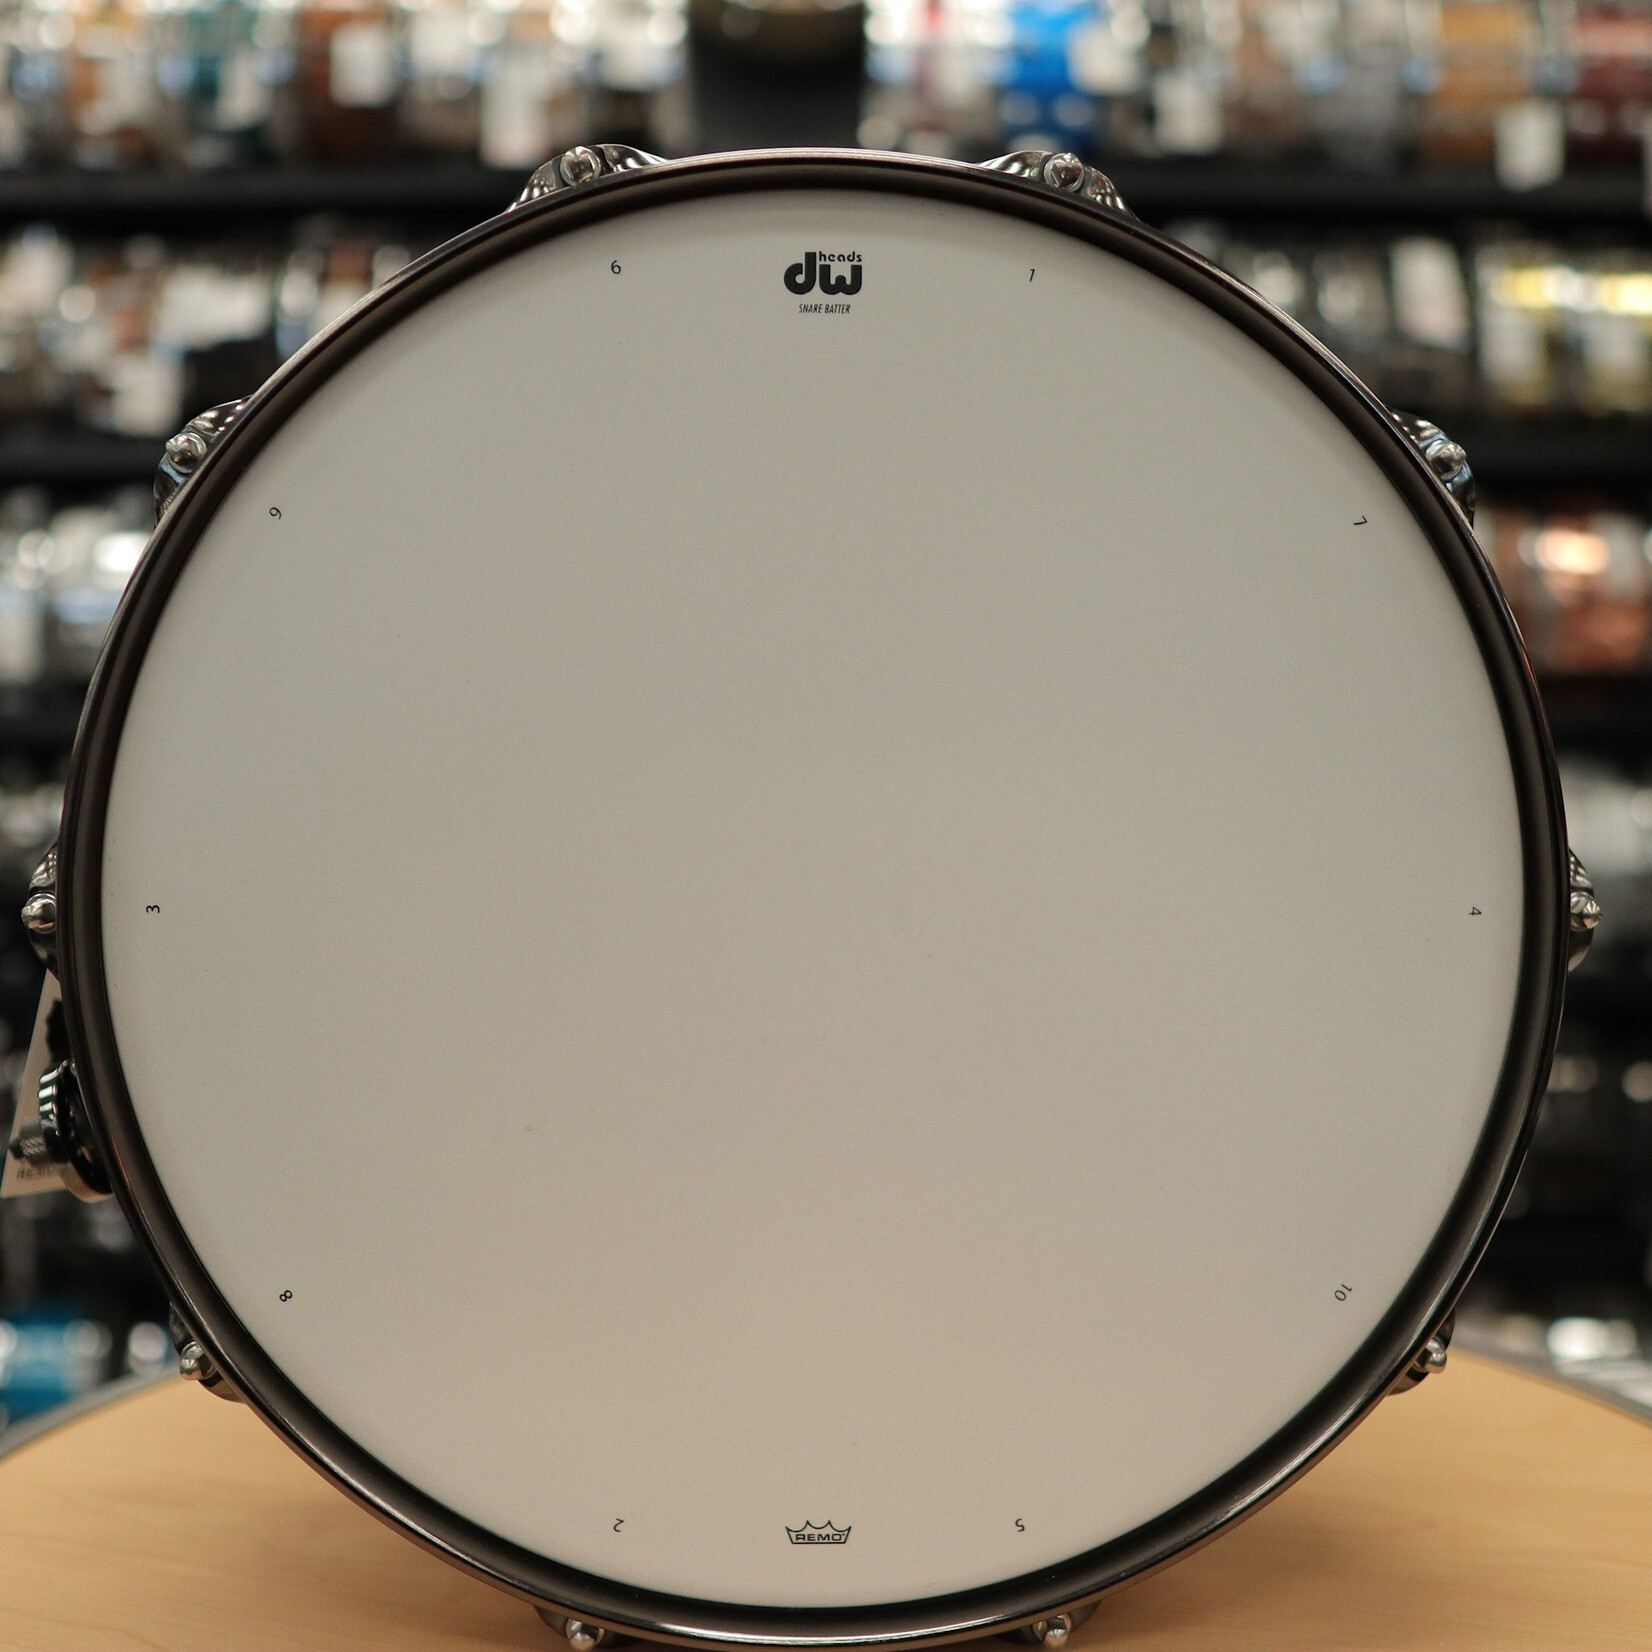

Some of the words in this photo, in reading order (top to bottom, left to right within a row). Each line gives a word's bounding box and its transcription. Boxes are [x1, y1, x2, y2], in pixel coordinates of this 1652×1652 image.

[818, 250, 863, 263] heads
[611, 259, 622, 275] 6
[783, 251, 863, 296] dw
[1028, 268, 1036, 283] 1
[798, 303, 823, 315] SNARE
[824, 303, 851, 315] BATTER
[268, 506, 282, 520] 9
[1352, 514, 1368, 526] 7
[145, 904, 161, 915] 3
[1468, 906, 1483, 917] 4
[278, 1289, 294, 1303] 8
[1333, 1283, 1353, 1302] 10
[612, 1517, 625, 1533] 2
[1014, 1517, 1026, 1533] 5
